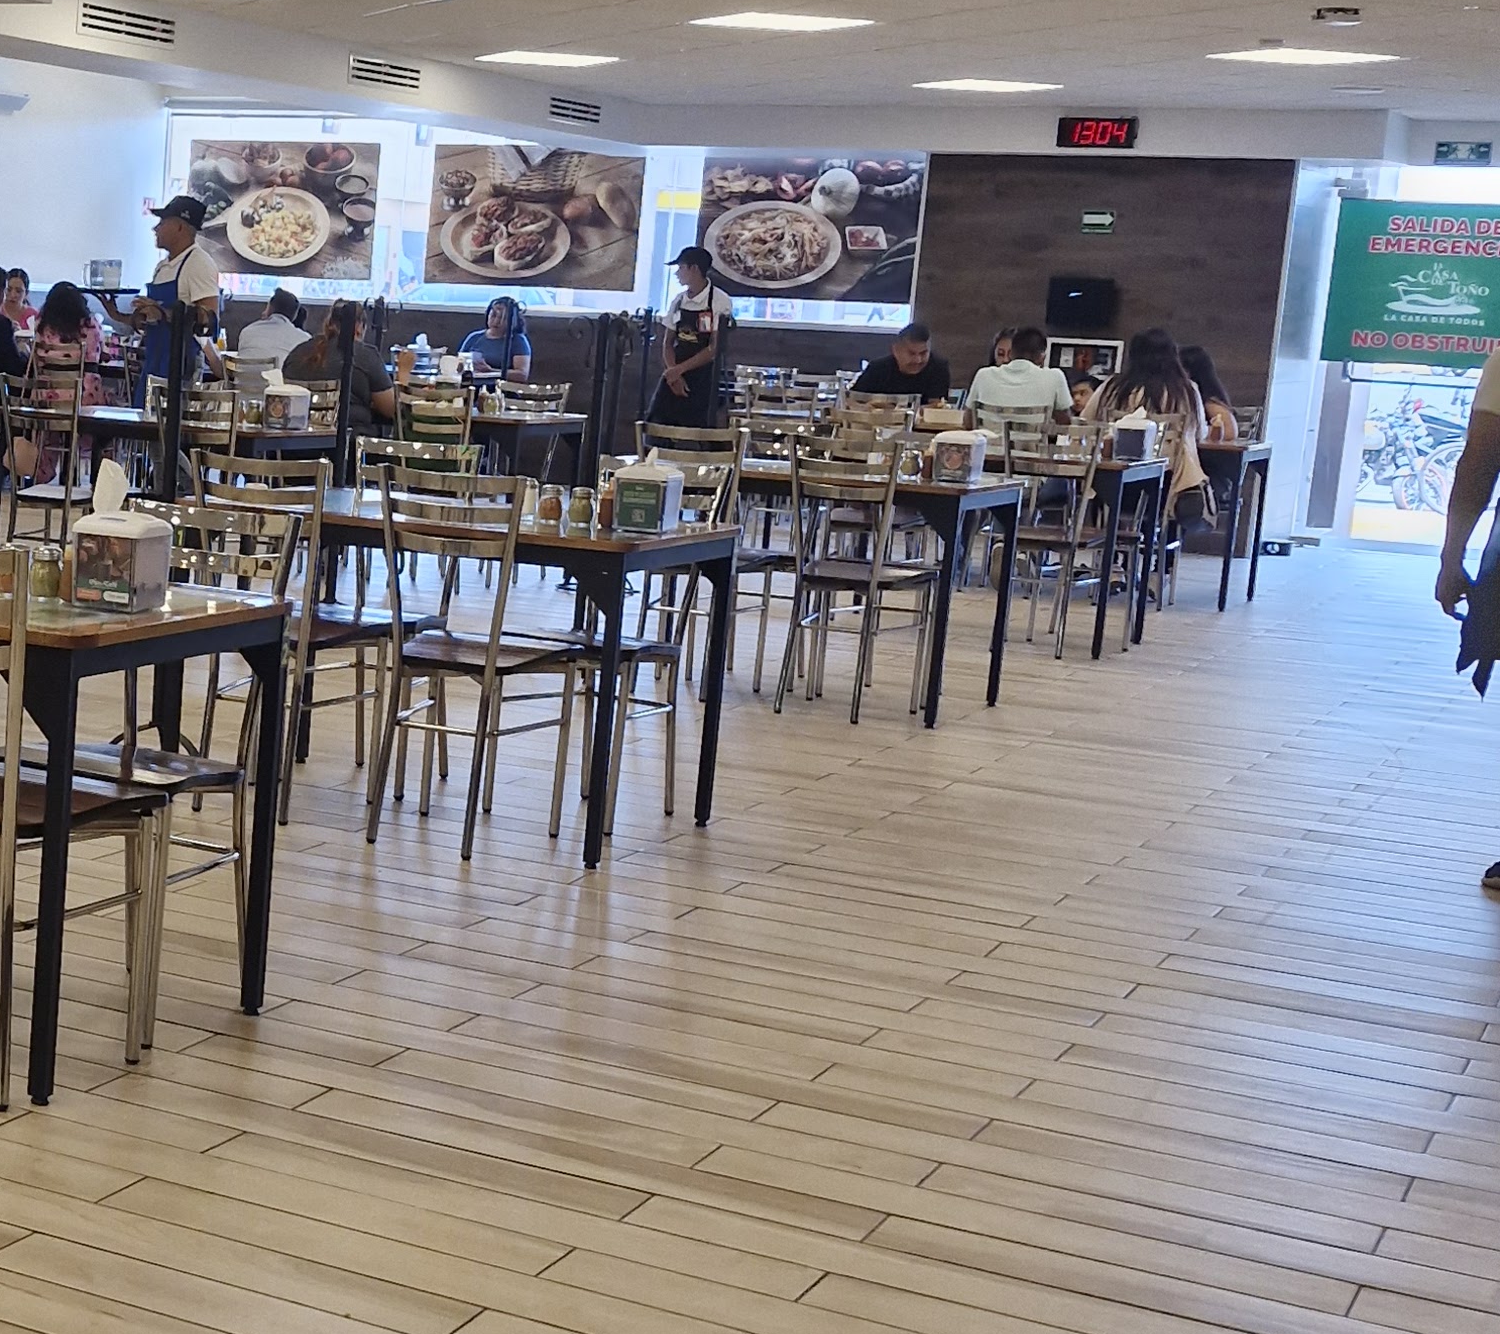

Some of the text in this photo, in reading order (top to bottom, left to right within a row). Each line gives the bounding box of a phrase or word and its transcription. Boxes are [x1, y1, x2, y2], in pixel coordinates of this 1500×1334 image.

[1389, 215, 1500, 237] SALIDA DE
[1369, 235, 1500, 257] EMERGENC
[1417, 270, 1458, 283] CASA
[1400, 314, 1428, 323] CASA
[1431, 316, 1445, 324] DE
[1449, 317, 1485, 326] TODOS
[1351, 329, 1500, 355] NO OBSTRUI
